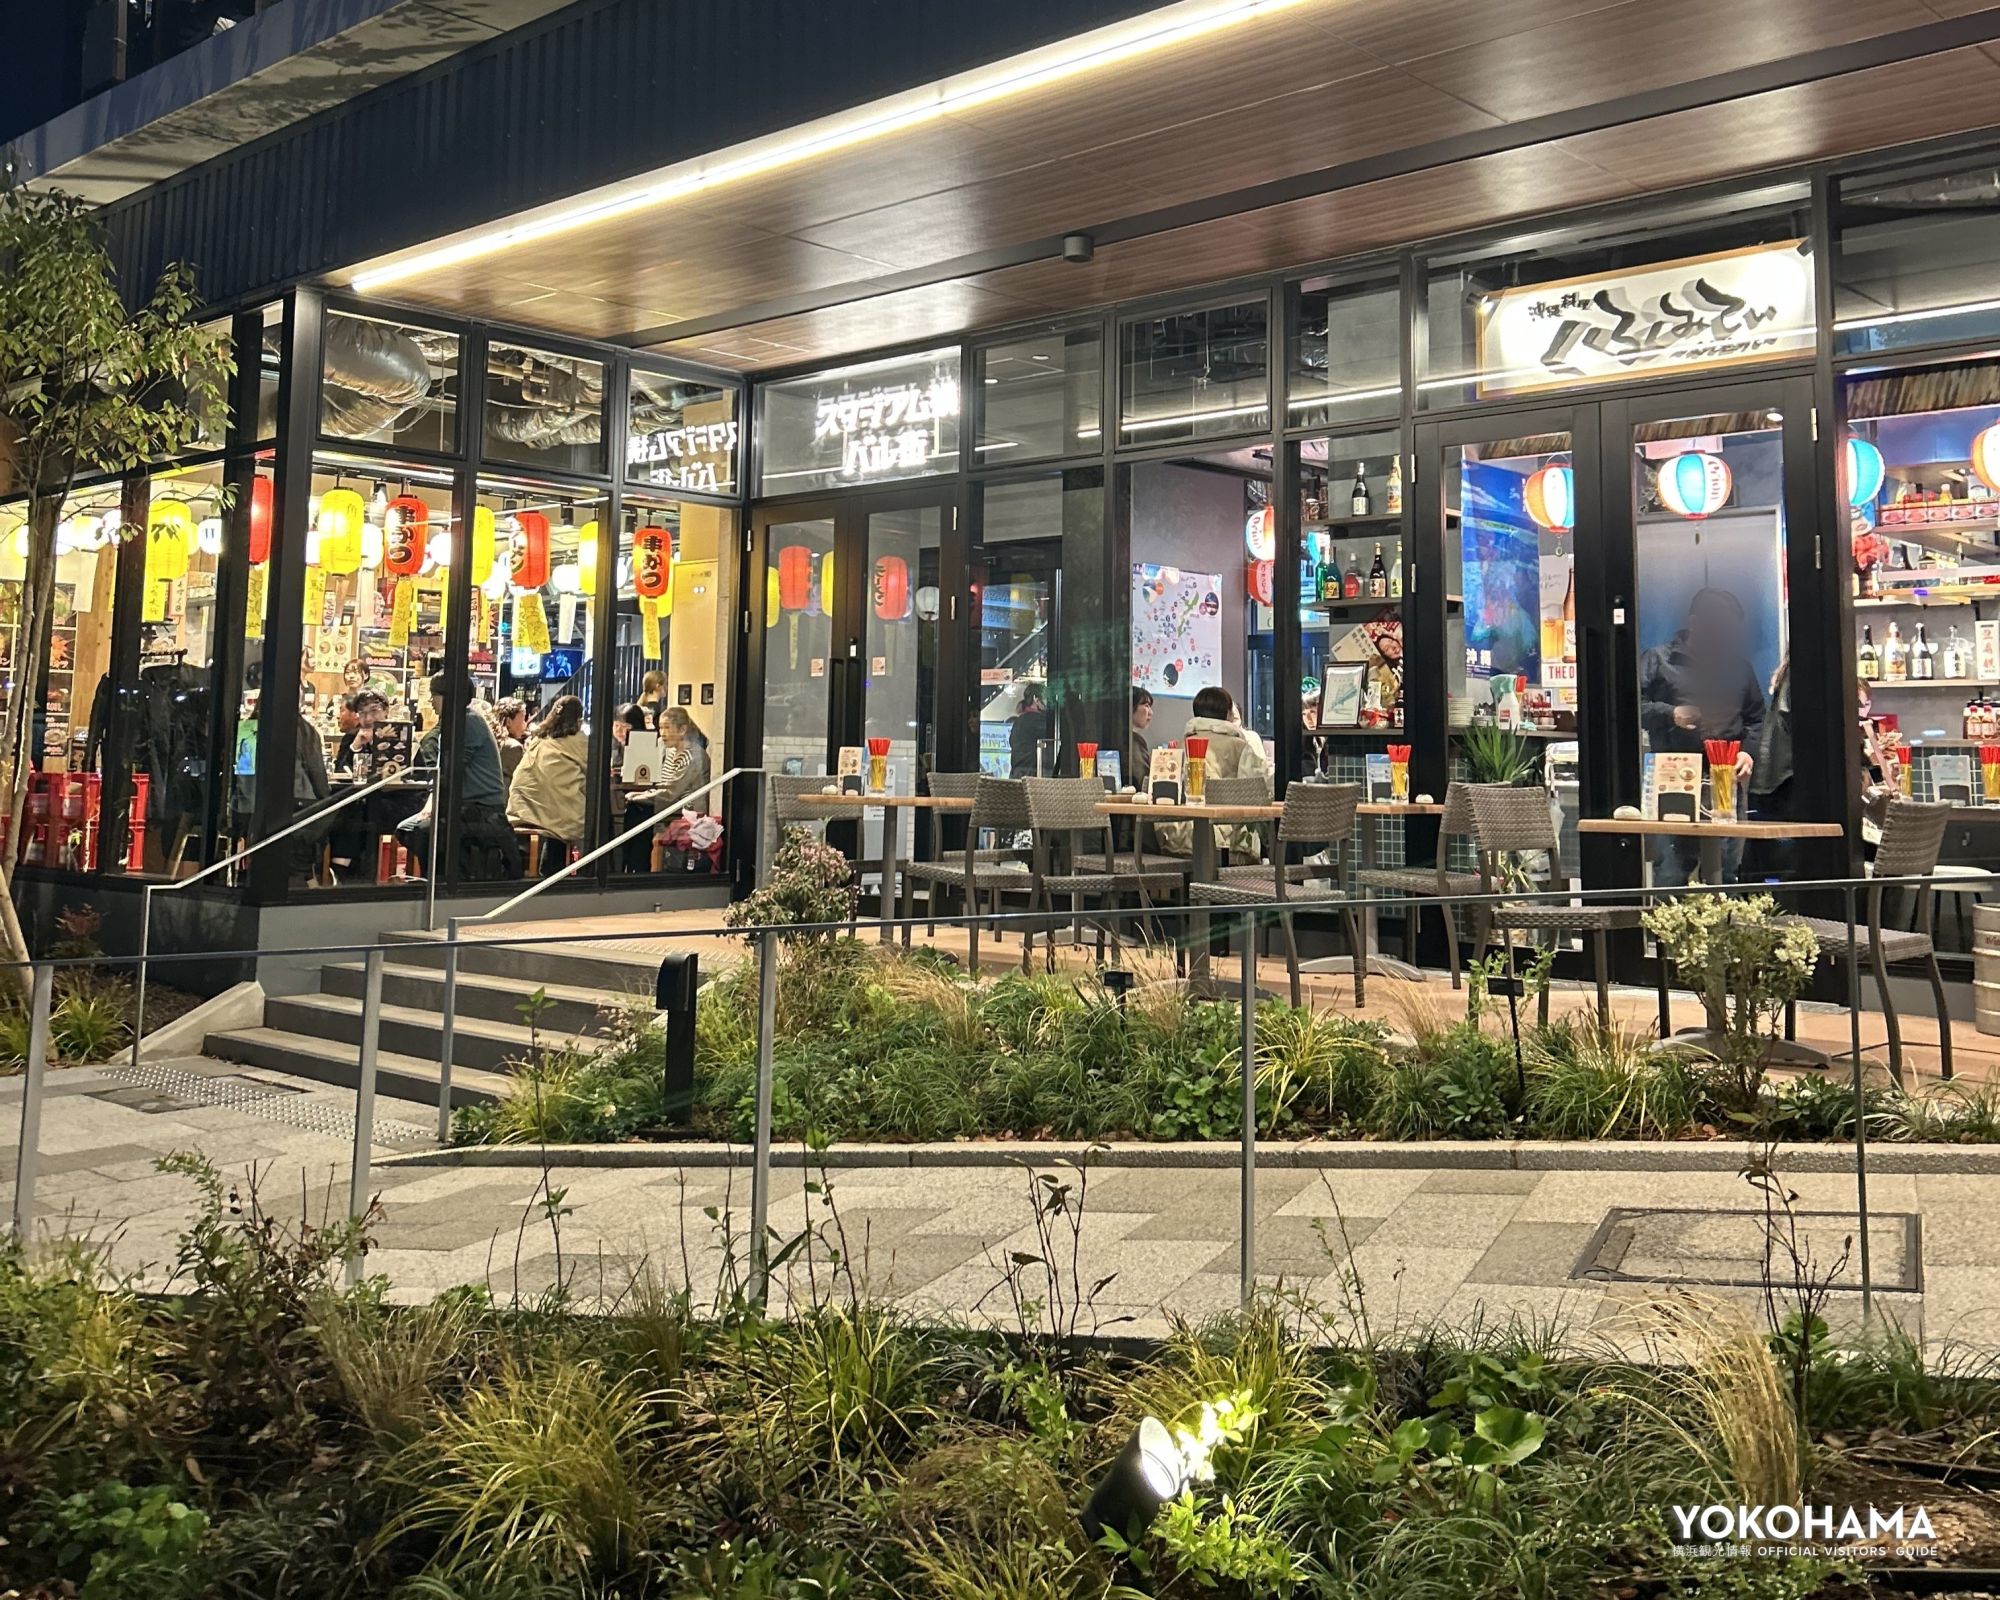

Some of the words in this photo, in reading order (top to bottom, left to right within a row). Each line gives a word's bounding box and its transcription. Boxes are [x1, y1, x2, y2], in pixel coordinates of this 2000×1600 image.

[389, 505, 416, 563] 串かつ
[642, 535, 663, 588] 串かつ
[1548, 665, 1567, 679] THE
